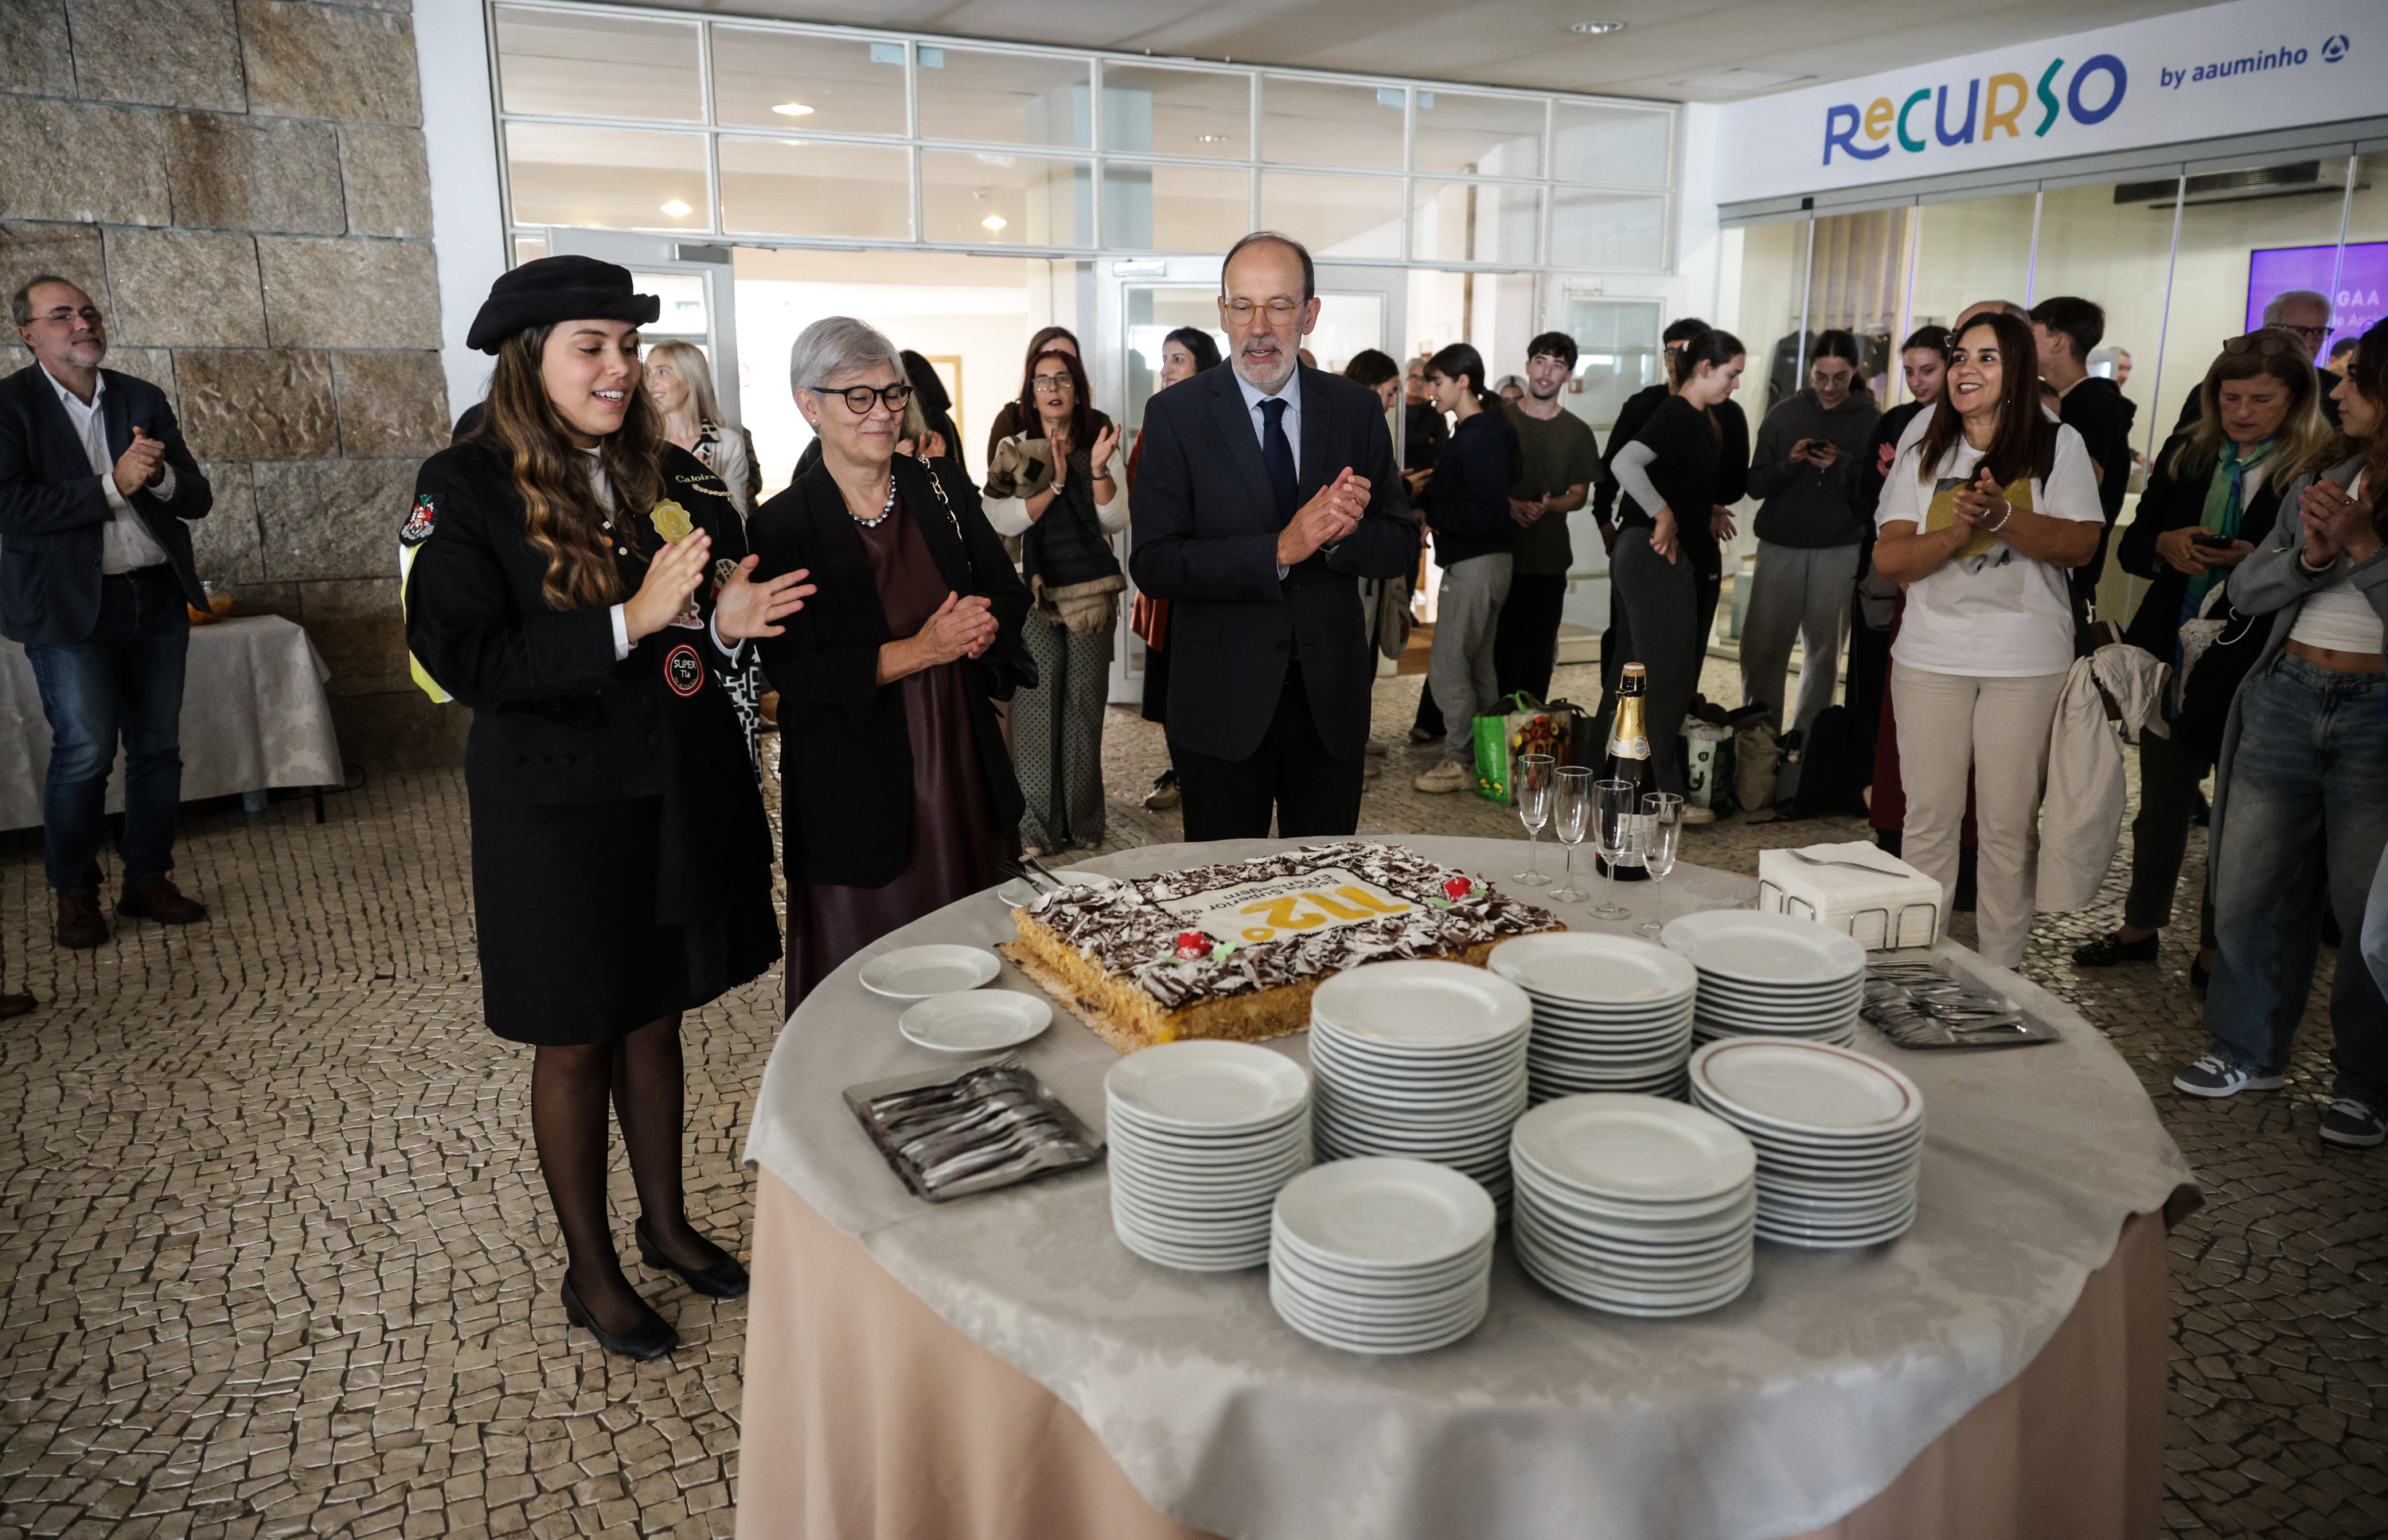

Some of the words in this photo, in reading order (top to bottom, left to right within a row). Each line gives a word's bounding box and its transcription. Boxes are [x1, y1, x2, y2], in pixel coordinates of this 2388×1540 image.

[2160, 67, 2186, 89] by
[2192, 46, 2308, 81] aauminho
[673, 659, 696, 669] SUPER
[1286, 878, 1341, 891] Escola
[1210, 887, 1284, 911] Superior
